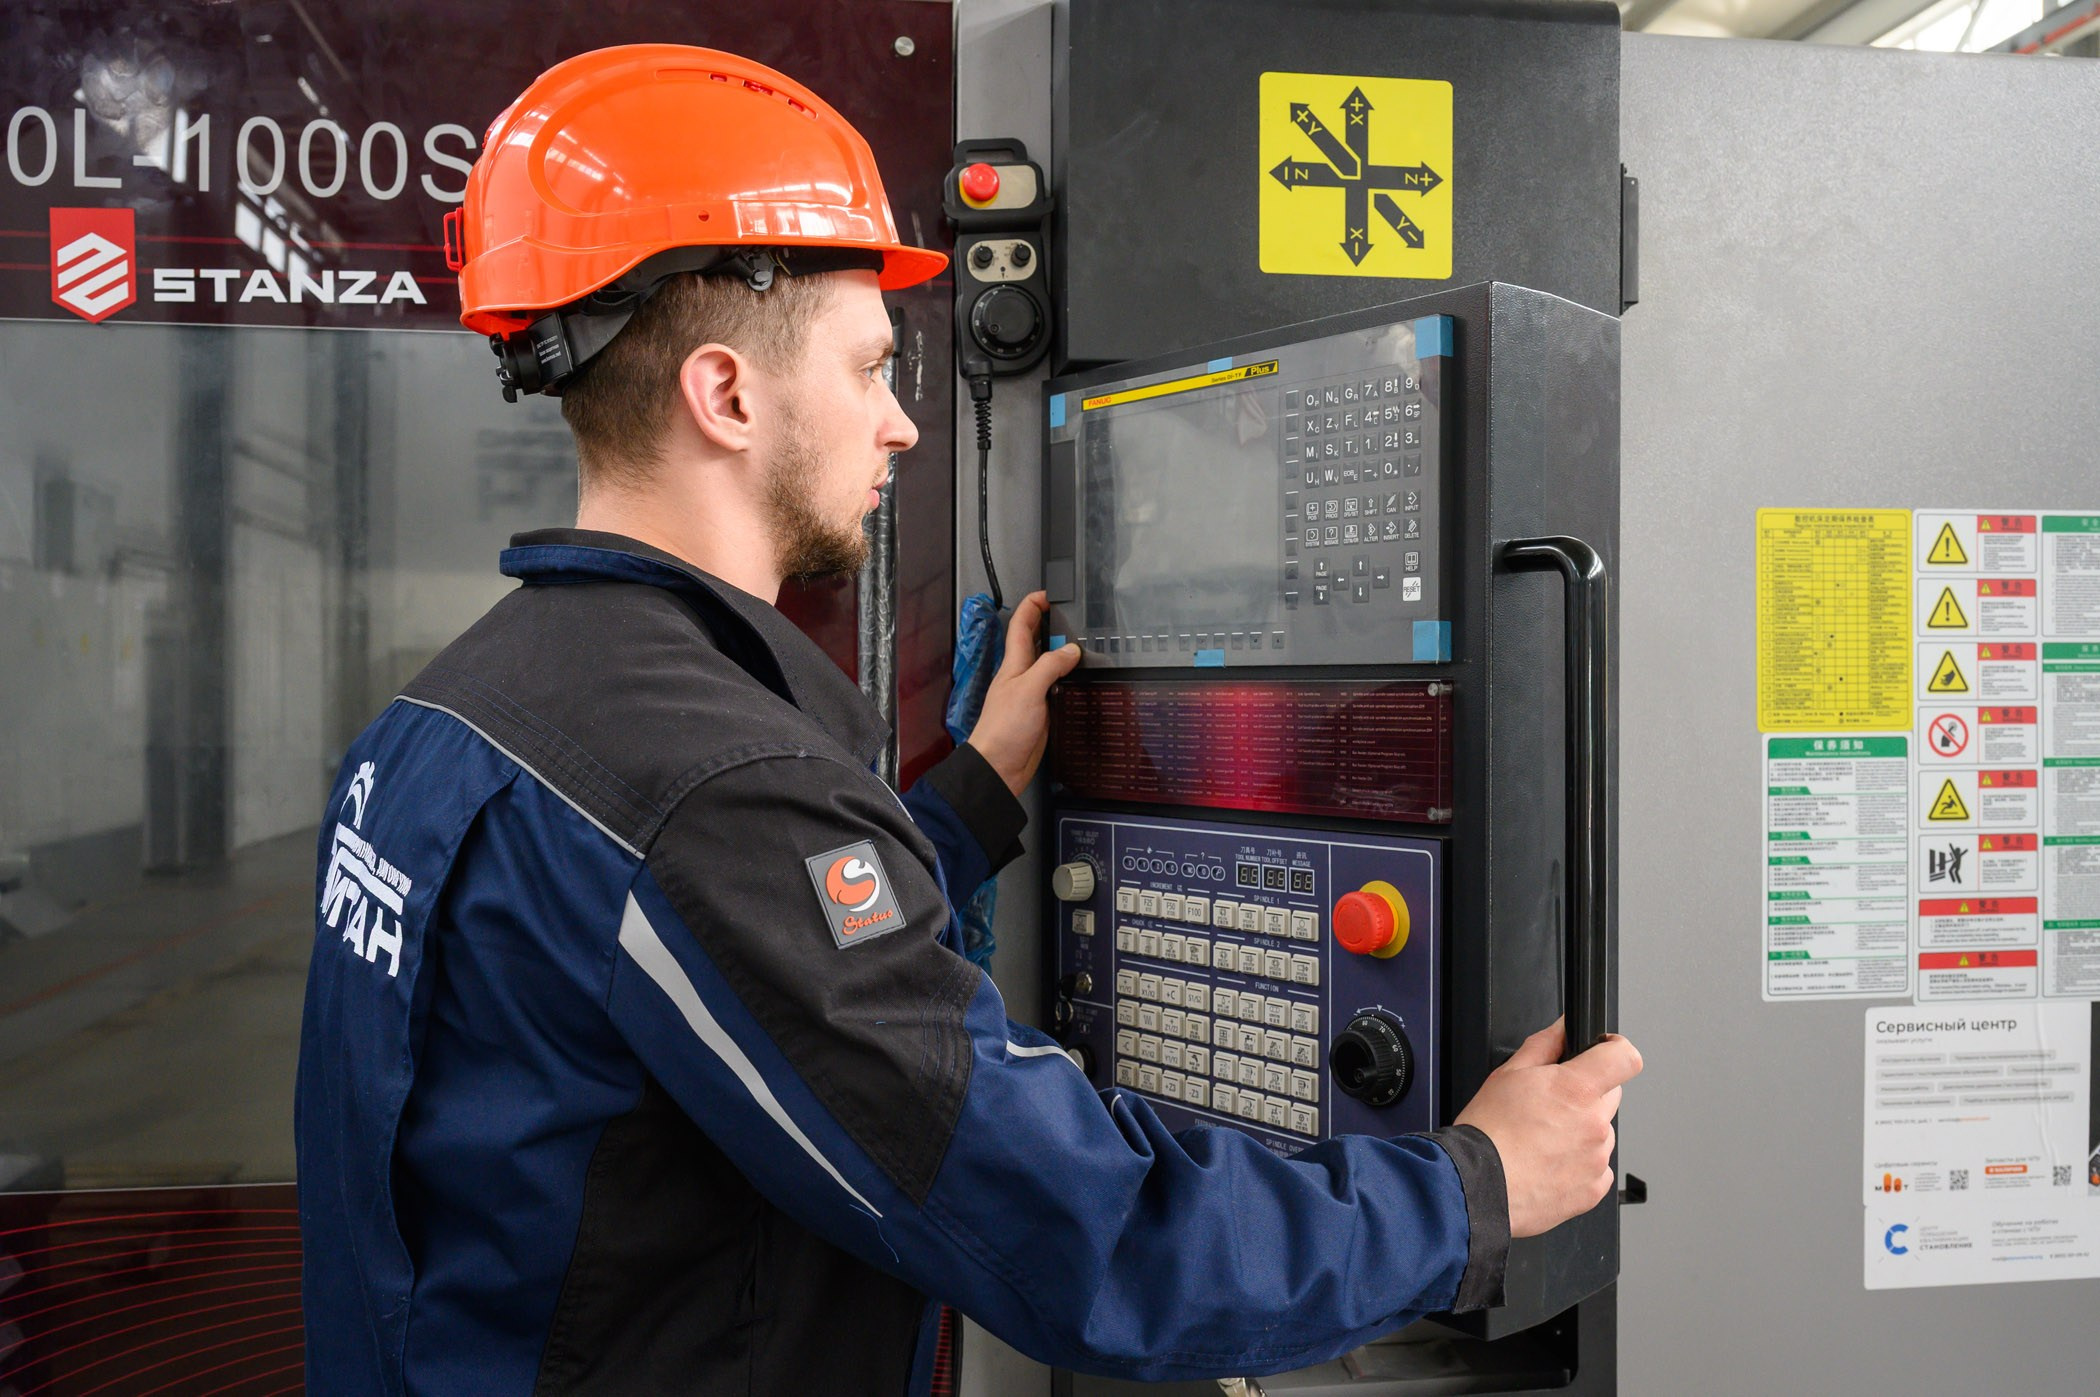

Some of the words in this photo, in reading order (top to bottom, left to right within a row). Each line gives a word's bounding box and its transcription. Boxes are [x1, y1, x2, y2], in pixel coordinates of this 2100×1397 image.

[153, 267, 427, 304] STANZA
[1250, 365, 1270, 376] Plus
[1088, 396, 1112, 407] FANUC
[1383, 533, 1399, 541] INSERT
[1813, 740, 1864, 751] 保养须知
[1245, 854, 1261, 862] NUMBER
[1150, 882, 1173, 890] INCREMENT
[1143, 899, 1153, 907] F25
[1253, 895, 1274, 904] SPINDLE
[1166, 902, 1175, 910] F50
[1187, 907, 1201, 916] F100
[842, 909, 894, 936] Status
[1253, 937, 1274, 947] SPINDLE
[1255, 981, 1280, 992] FUNCTION
[1166, 990, 1175, 1000] +C
[1379, 1026, 1386, 1034] 70
[1876, 1018, 1966, 1035] Сервисный
[1970, 1018, 2018, 1033] центр
[1165, 1083, 1176, 1092] +Z3
[1265, 1139, 1287, 1151] SPINDLE
[1919, 1243, 1973, 1251] СТАНОВЛЕНИЕ
